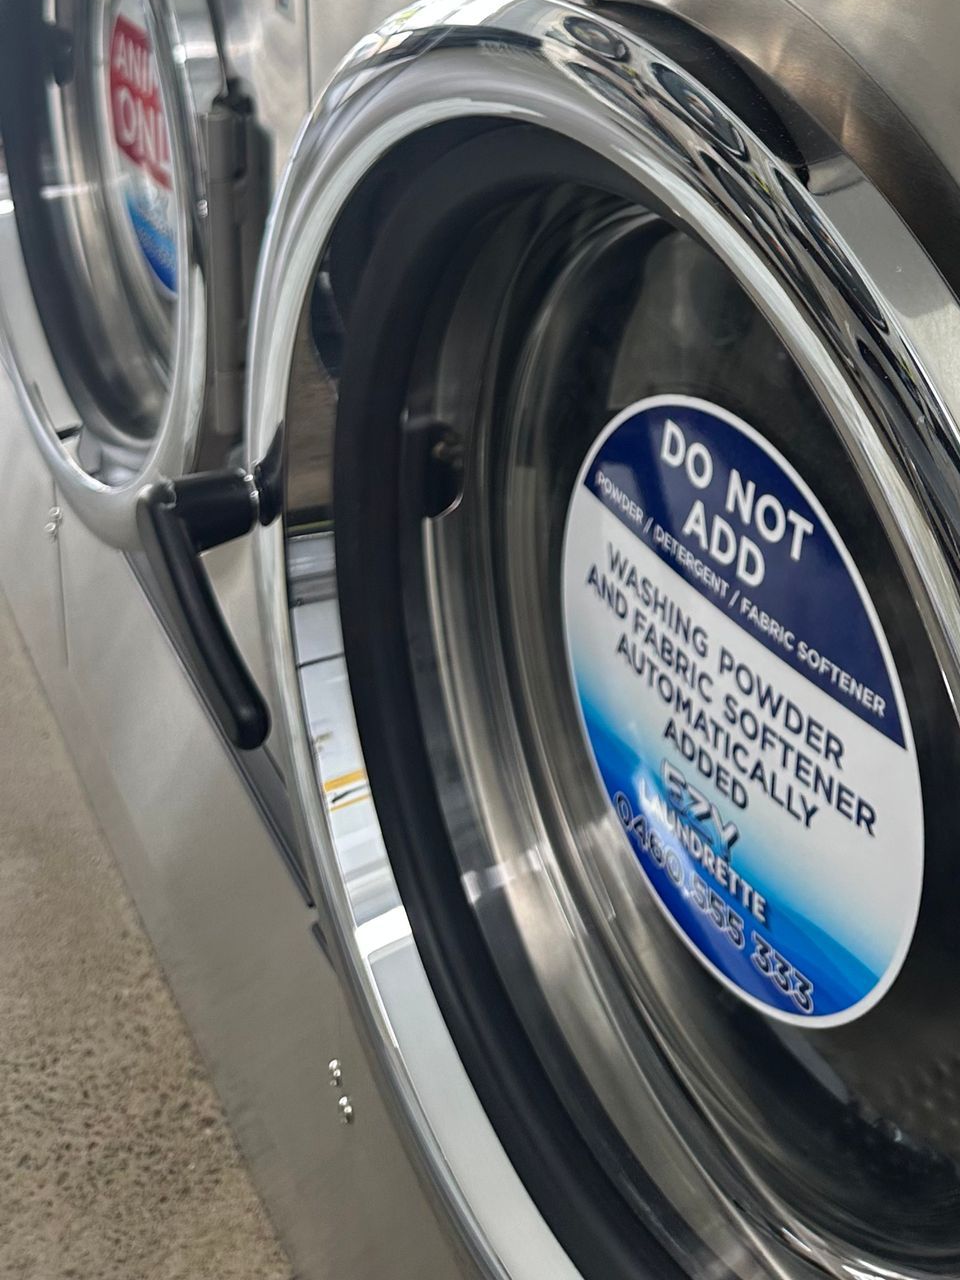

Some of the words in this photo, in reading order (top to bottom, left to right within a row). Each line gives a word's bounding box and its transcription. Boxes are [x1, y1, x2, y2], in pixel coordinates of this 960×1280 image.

[660, 419, 713, 490] DO
[725, 468, 814, 561] NOT
[683, 500, 765, 587] ADD
[595, 471, 645, 521] POWDER
[653, 526, 731, 600] DETERGENT
[740, 597, 796, 651] FABRIC
[798, 641, 887, 719] SOFTENER
[606, 542, 709, 659] WASHING
[719, 649, 845, 770] POWDER
[586, 563, 628, 621] AND
[633, 609, 714, 704] FABRIC
[723, 694, 877, 838] SOFTENER
[616, 632, 819, 829] AUTOMATICALLY
[663, 718, 749, 810] ADDED
[639, 777, 767, 923] LAUNDRETTE
[662, 758, 740, 862] EZY
[613, 791, 685, 888] 0460
[687, 871, 746, 950] 555
[752, 931, 815, 1015] 333
